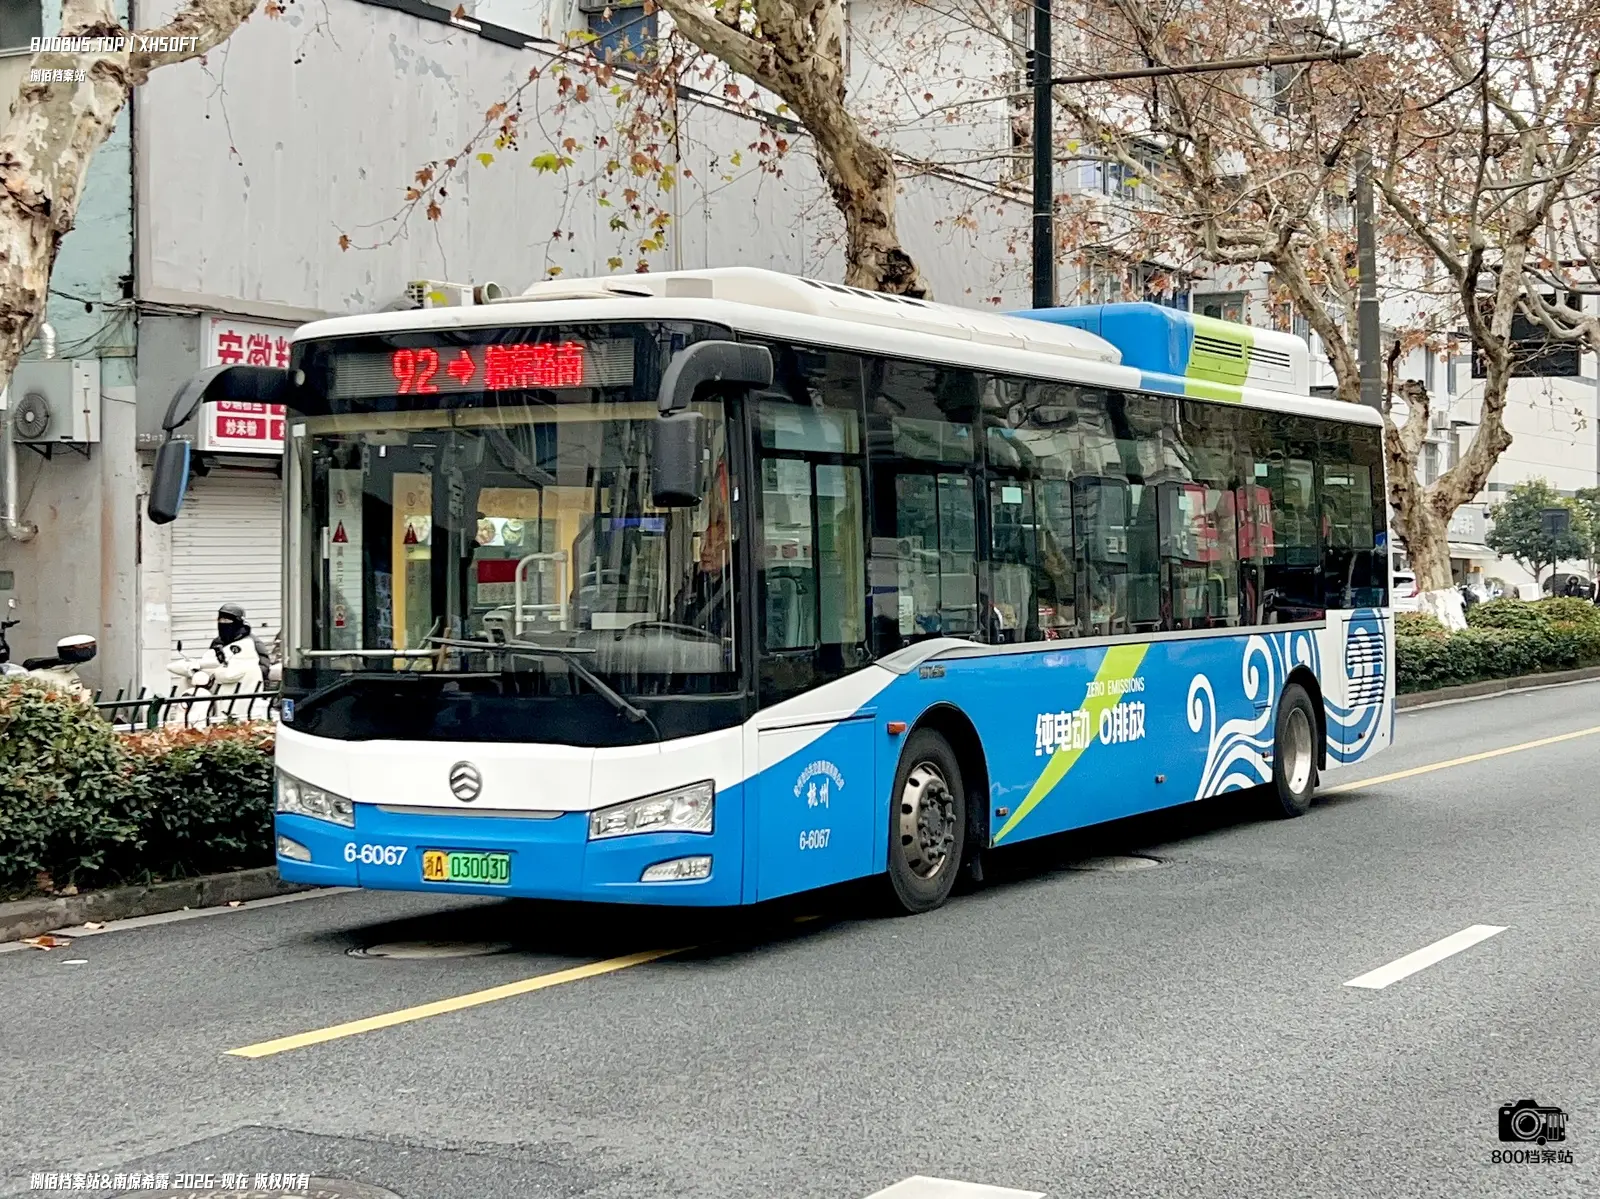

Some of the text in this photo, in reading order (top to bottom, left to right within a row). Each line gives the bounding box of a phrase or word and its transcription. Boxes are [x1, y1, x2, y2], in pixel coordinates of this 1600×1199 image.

[392, 348, 439, 394] 92
[1086, 677, 1145, 698] ZERO EMISSIONS
[1034, 707, 1091, 757] 纯电动
[799, 828, 831, 851] 6-6067
[343, 842, 408, 866] 6-6067
